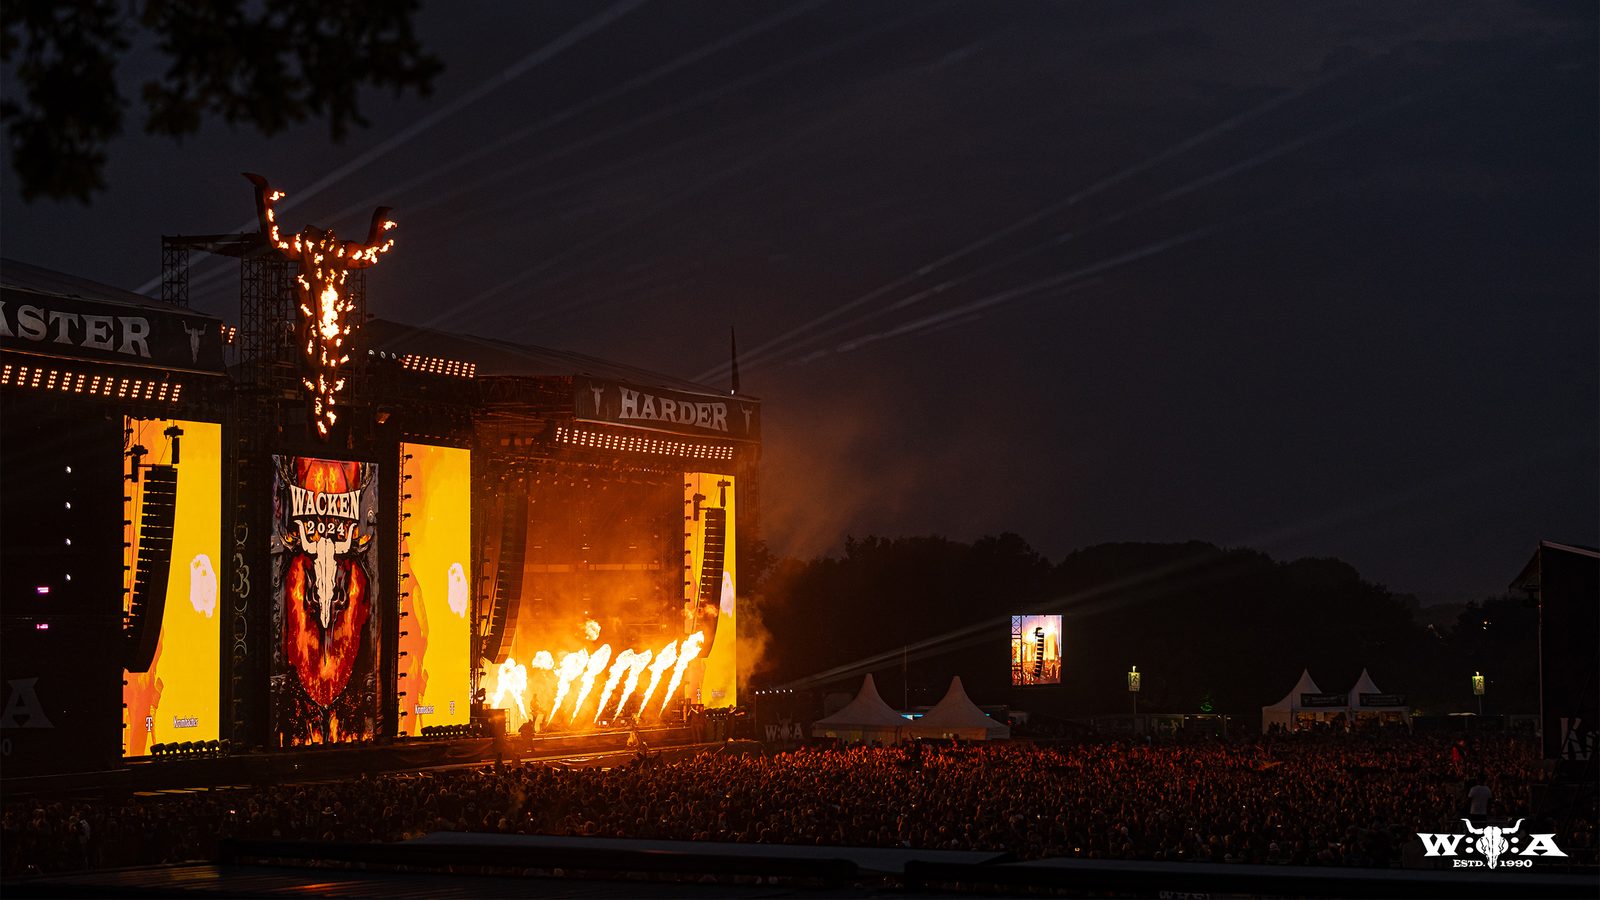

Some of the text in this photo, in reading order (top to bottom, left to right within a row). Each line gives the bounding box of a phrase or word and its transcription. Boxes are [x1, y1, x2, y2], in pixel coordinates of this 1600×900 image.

[619, 386, 728, 432] HARDER
[290, 484, 361, 521] WACKEN
[307, 520, 345, 537] 2024
